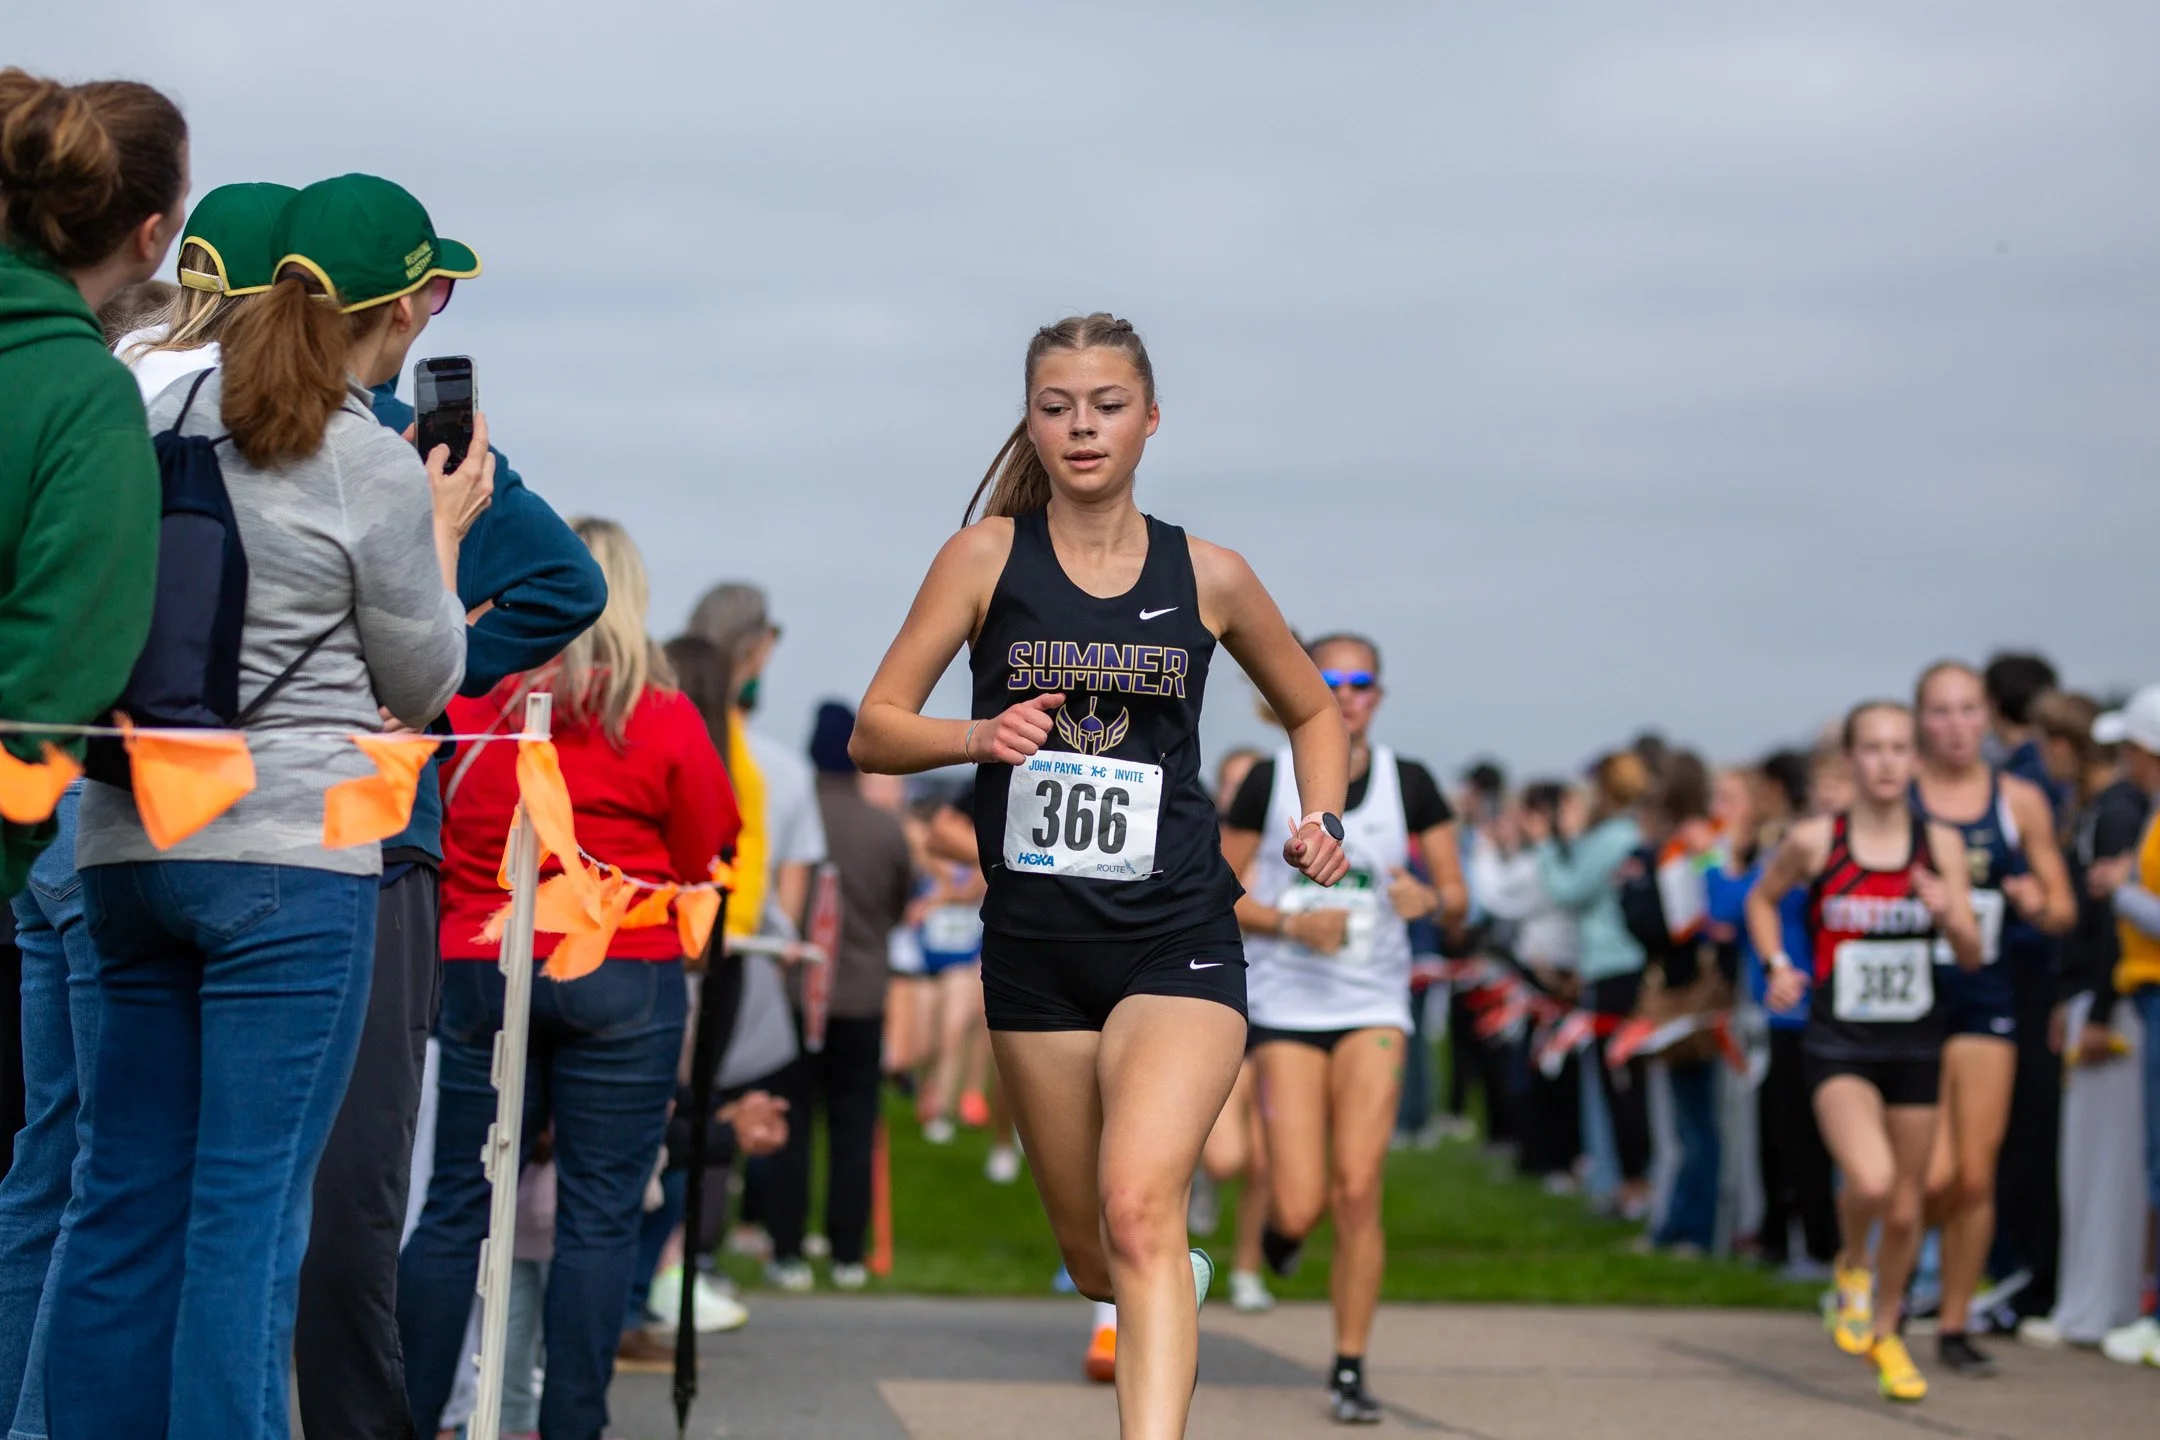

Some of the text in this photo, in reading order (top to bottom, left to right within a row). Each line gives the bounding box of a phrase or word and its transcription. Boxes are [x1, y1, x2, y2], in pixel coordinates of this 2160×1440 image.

[1008, 640, 1188, 699] SUMNER
[1028, 759, 1053, 773] JOHN
[1054, 761, 1083, 776] PAYNE
[1114, 768, 1144, 784] INVITE
[1032, 779, 1130, 855] 366
[1017, 852, 1054, 868] HOKA
[1096, 863, 1126, 874] ROUTE
[1858, 964, 1915, 1001] 382
